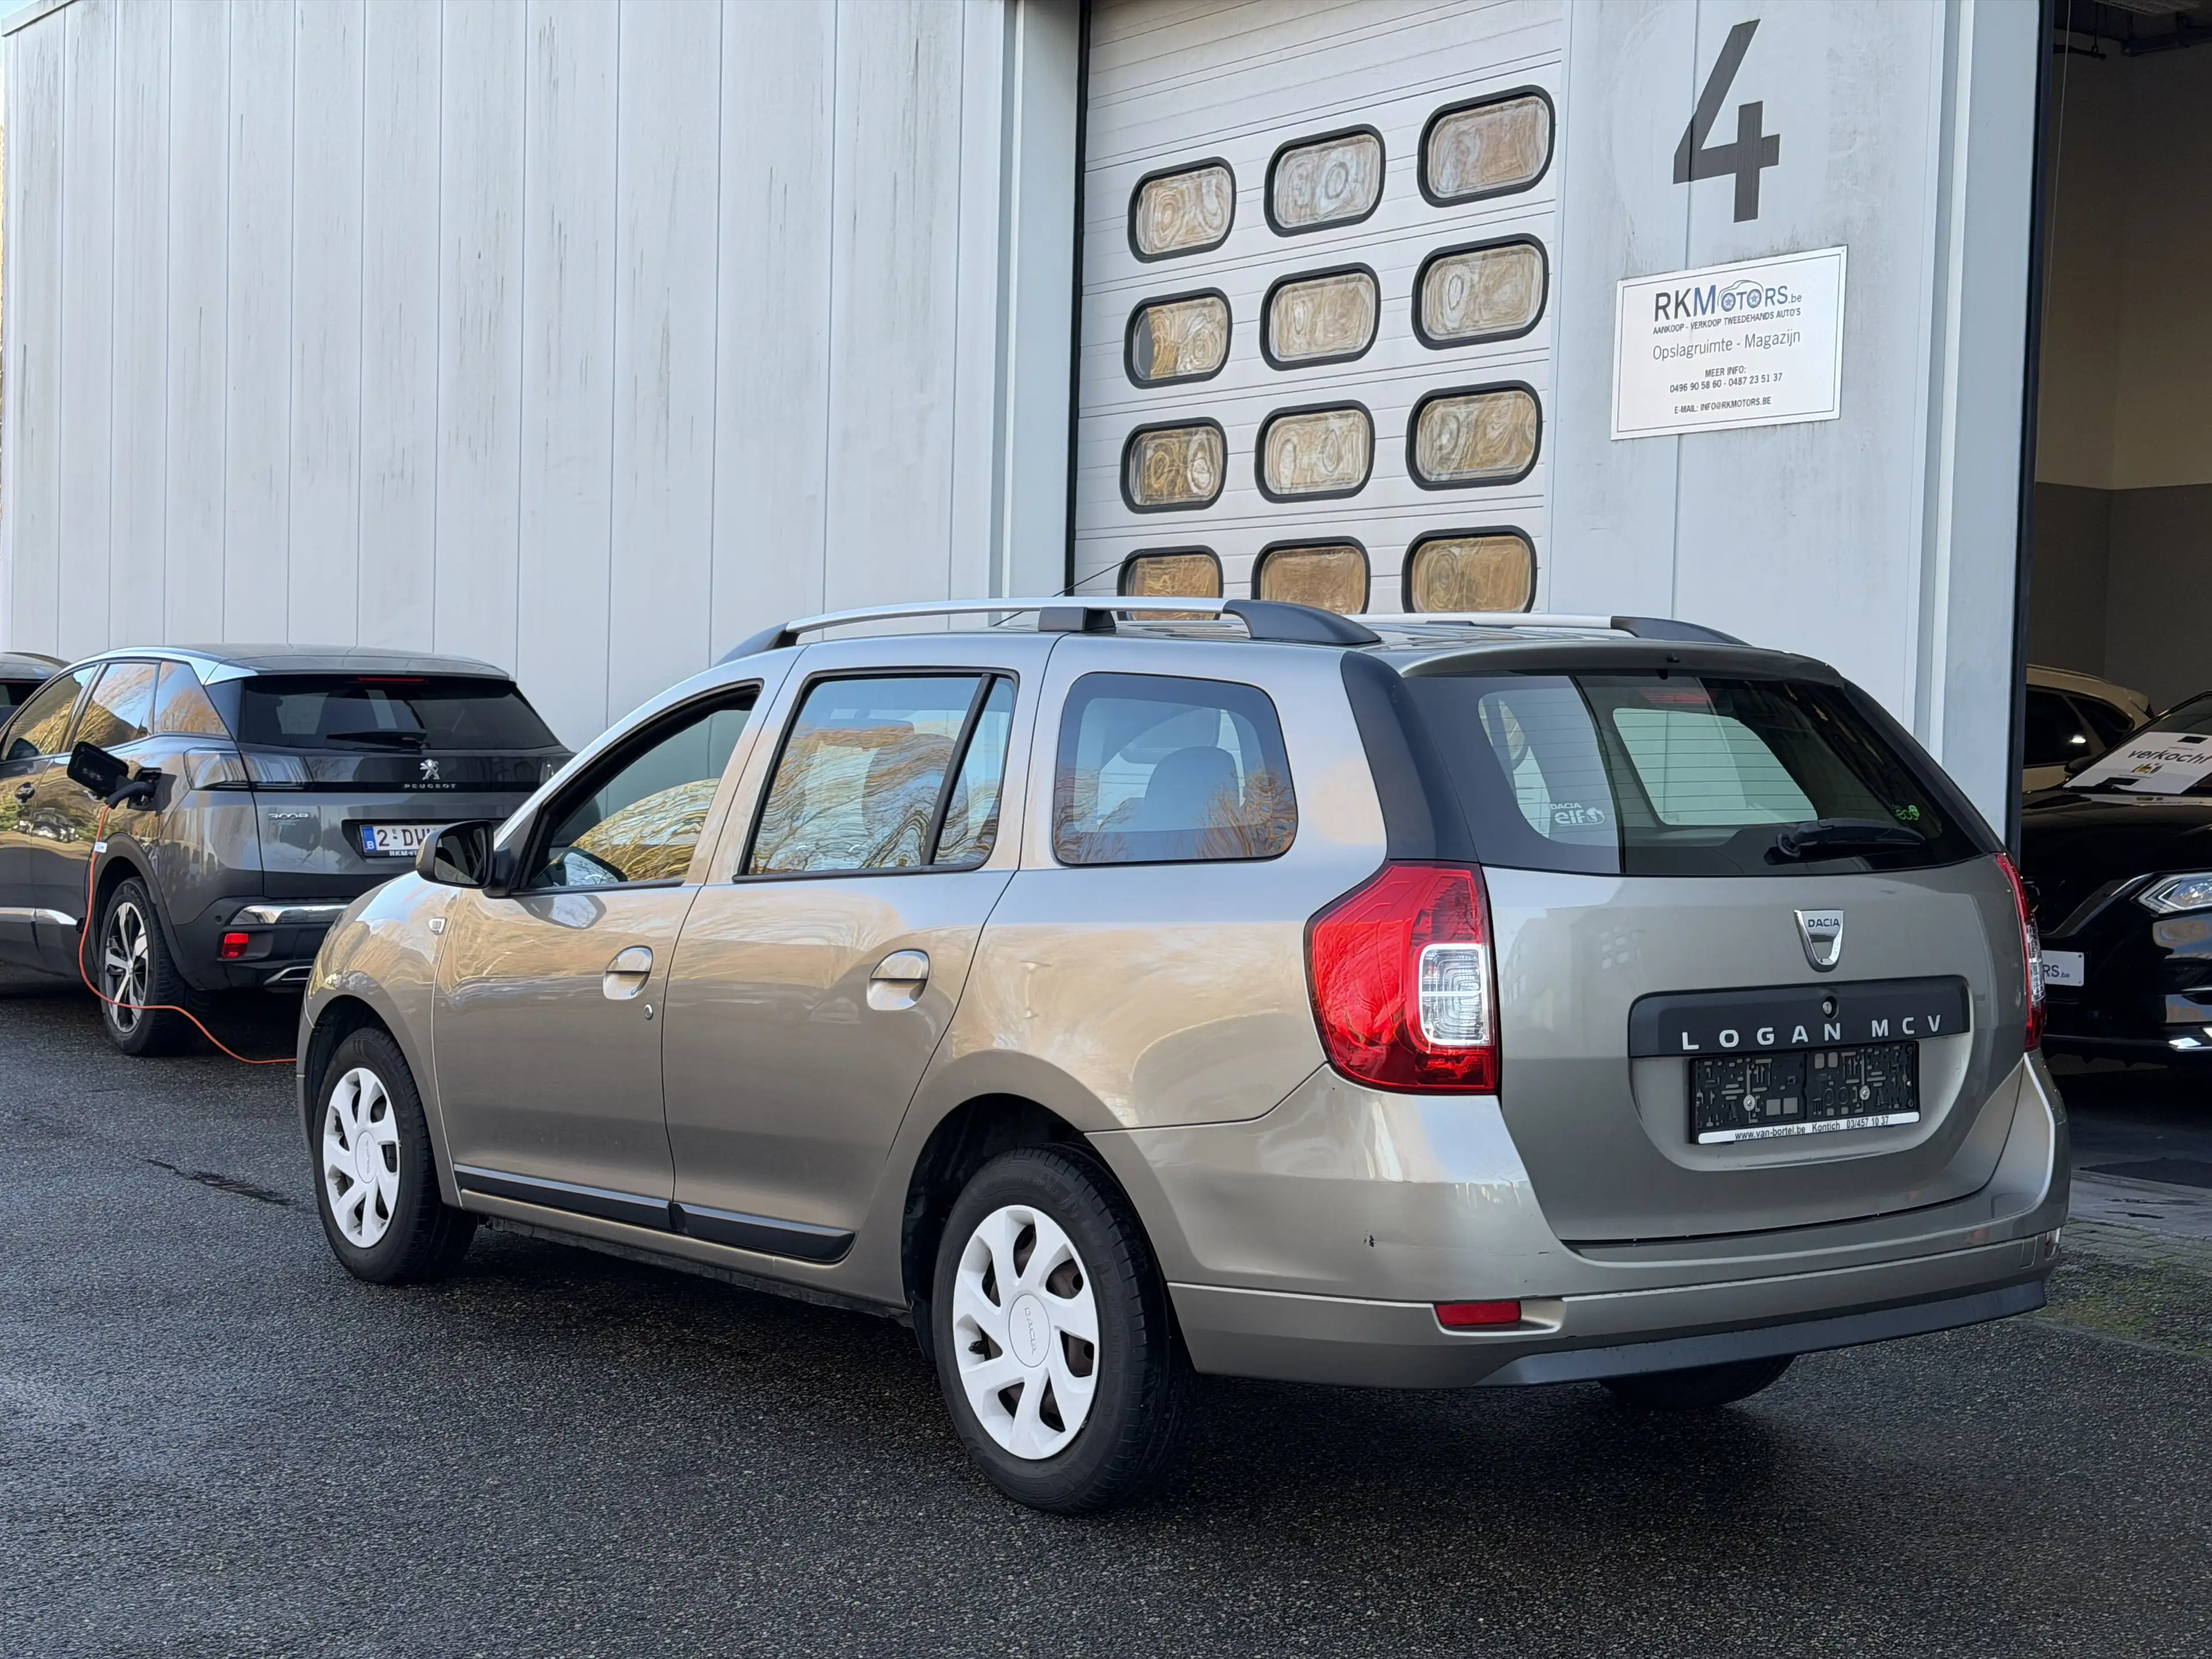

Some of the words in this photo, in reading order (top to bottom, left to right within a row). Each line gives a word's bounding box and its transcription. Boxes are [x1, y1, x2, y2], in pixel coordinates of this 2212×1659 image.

[1673, 18, 1780, 223] 4
[1653, 324, 1684, 335] AANKOOP
[1691, 319, 1722, 331] VERKOOP
[1724, 312, 1774, 325] TWEEDEHANDS
[1776, 308, 1801, 319] AUTO'S
[1653, 338, 1733, 361] Opslagruimte
[1744, 329, 1801, 349] Magazijn
[1705, 368, 1725, 378] MEER
[1727, 365, 1747, 376] INFO:
[1669, 383, 1688, 393] 0496
[1690, 382, 1699, 391] 90
[1701, 381, 1710, 389] 58
[1713, 379, 1722, 388] 60
[1728, 376, 1747, 387] 0487
[1749, 375, 1759, 384] 23
[1761, 374, 1770, 383] 51
[1773, 373, 1783, 381] 37
[1675, 405, 1698, 414] E-MAIL:
[1700, 396, 1771, 411] INFO@RKMOTORS.BE
[1554, 809, 1585, 824] elf
[366, 840, 374, 849] B
[1808, 918, 1840, 928] DACIA
[1682, 1023, 1840, 1050] LOGAN
[1872, 1014, 1941, 1037] MCV
[1734, 1126, 1805, 1140] www.van-bortel.be
[1812, 1121, 1840, 1132] Kontich
[1846, 1118, 1869, 1129] 03/457
[1872, 1117, 1879, 1126] 10
[1881, 1116, 1889, 1125] 37
